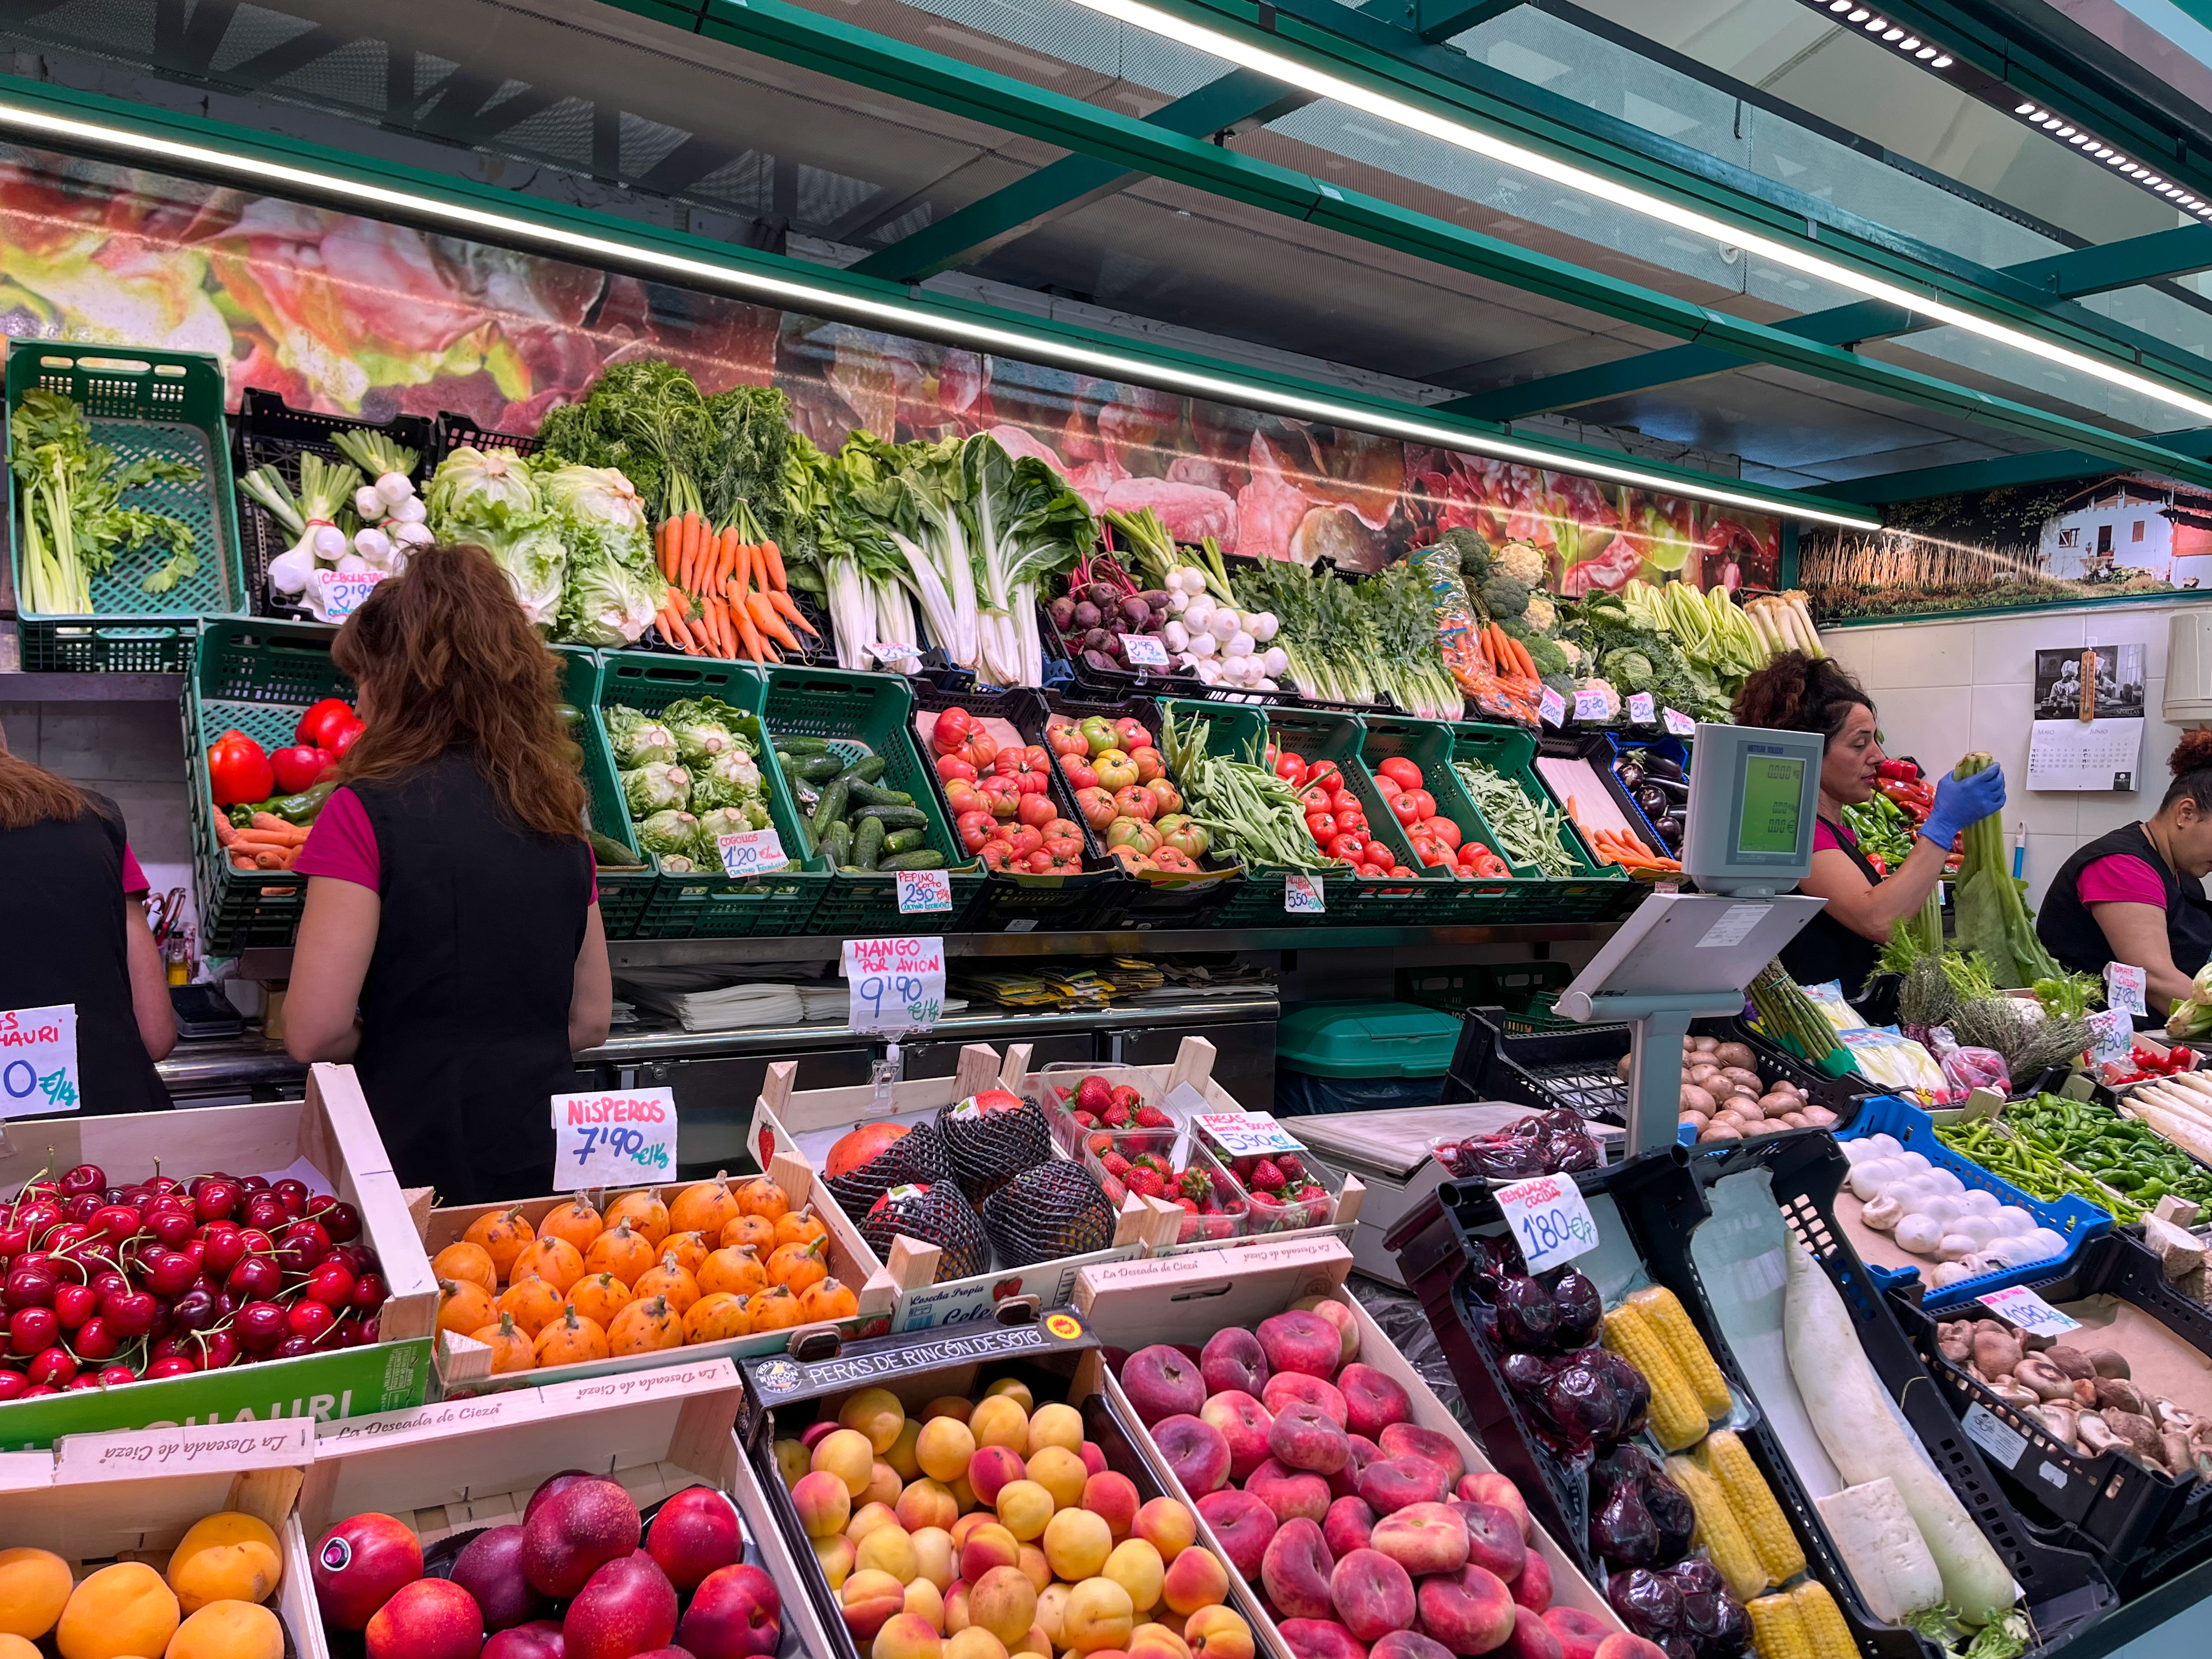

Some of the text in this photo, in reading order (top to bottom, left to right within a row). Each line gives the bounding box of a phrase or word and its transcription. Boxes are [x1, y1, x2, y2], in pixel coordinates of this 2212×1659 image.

[1129, 640, 1154, 656] 2'95
[1578, 696, 1603, 716] 3'20
[1747, 744, 1784, 754] METTLER TOLEDO
[720, 833, 758, 847] COGOLLOS
[724, 845, 757, 868] 1'20
[1287, 889, 1307, 908] 5'50
[854, 939, 921, 958] MANGO
[858, 957, 889, 974] POR
[2113, 964, 2134, 977] TOMATE
[860, 976, 922, 1018] 9'90
[2112, 985, 2136, 1007] 7'80
[1201, 1114, 1246, 1124] FRESAS
[573, 1127, 644, 1165] 7'90
[1218, 1133, 1272, 1150] 5'90
[1498, 1176, 1557, 1205] REMOLACHA
[1525, 1186, 1562, 1209] COCIDA
[1523, 1209, 1570, 1261] 1'80
[1318, 1244, 1330, 1252] La
[1102, 1260, 1198, 1279] La Deseada de Cieza
[912, 1285, 984, 1305] Cosecha Propia
[809, 1329, 1042, 1385] PERAS DE RINCÓN DE SOTO
[576, 1368, 718, 1400] La Deseada de Cieza
[335, 1402, 502, 1441] La Deseada de Cieza
[99, 1435, 287, 1464] La Deseada de Cieza
